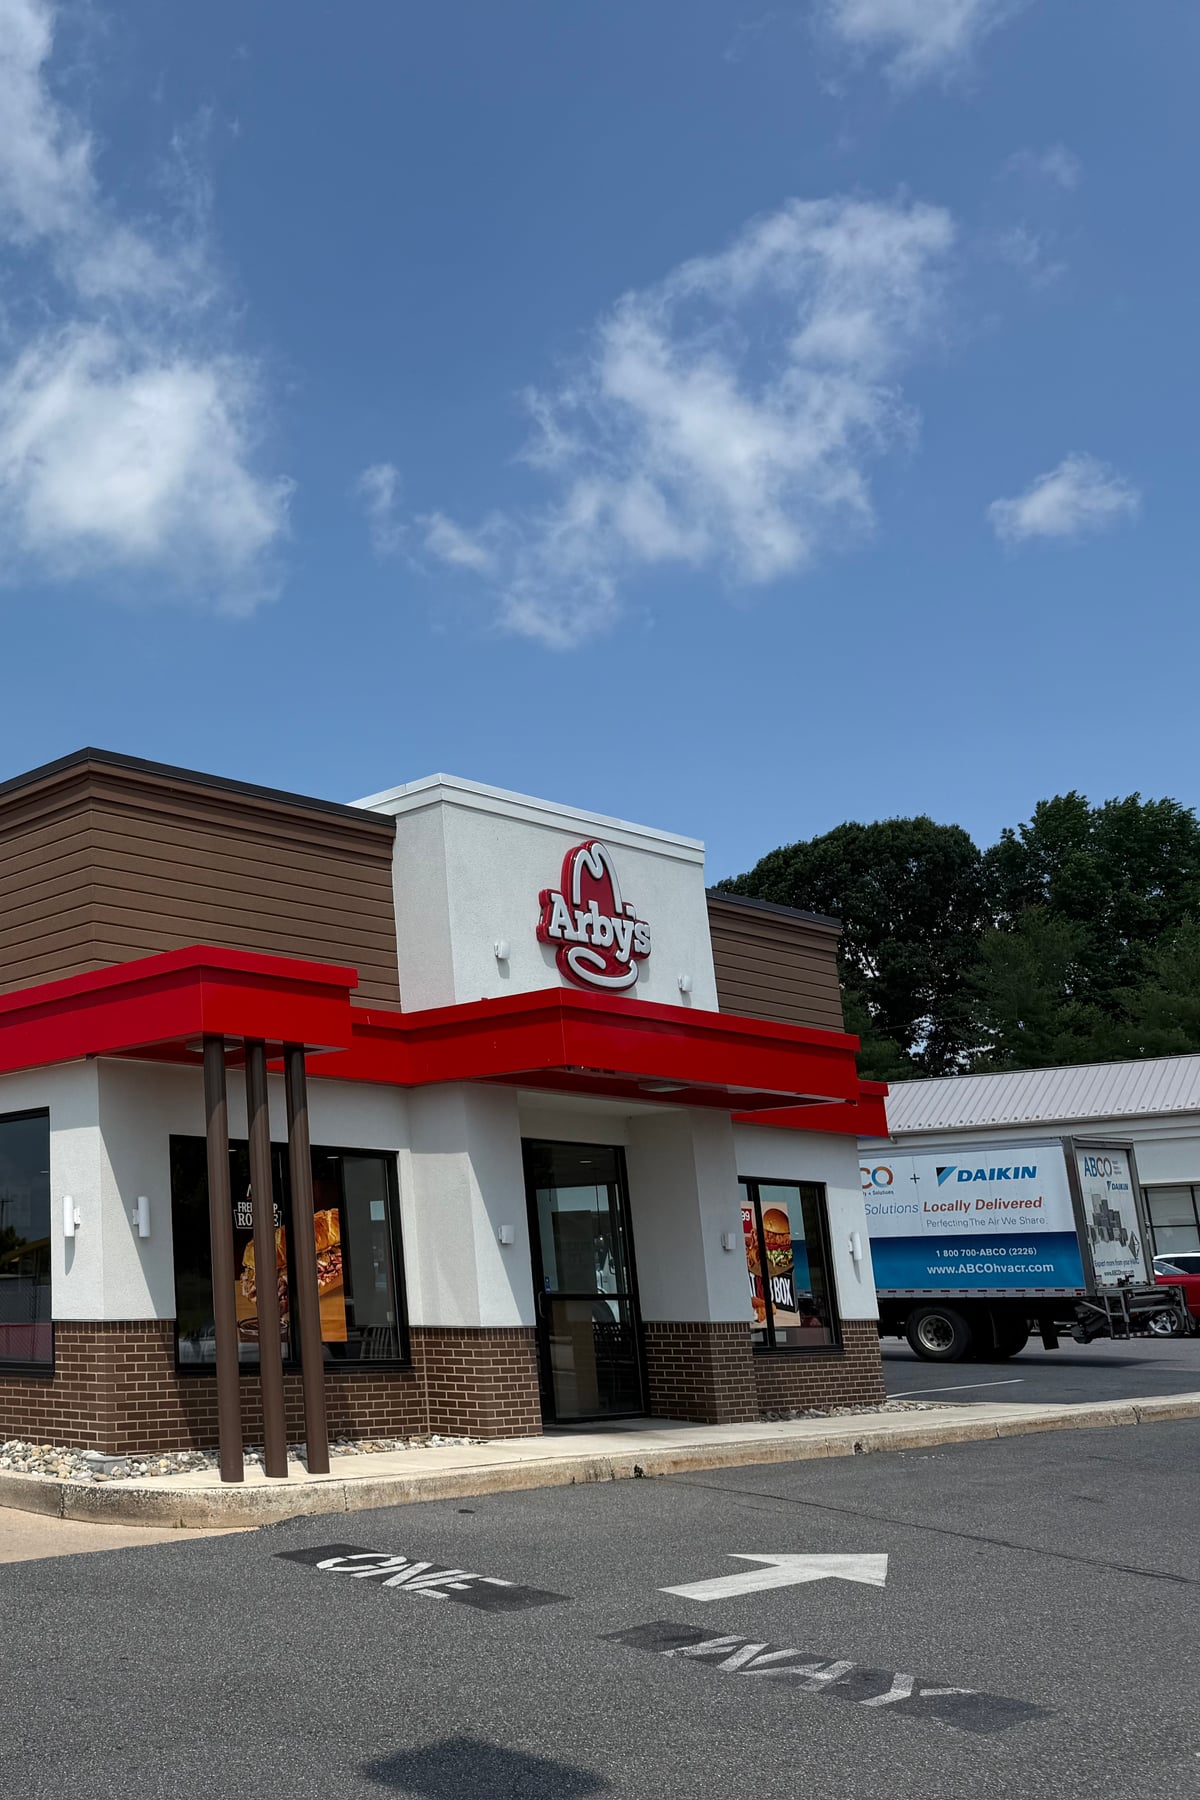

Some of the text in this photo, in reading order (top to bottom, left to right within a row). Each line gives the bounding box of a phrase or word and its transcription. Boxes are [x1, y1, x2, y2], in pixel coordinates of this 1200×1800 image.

[549, 893, 651, 963] Arby's
[957, 1166, 1037, 1182] DAIKIN
[1084, 1157, 1112, 1177] ABCO
[865, 1196, 1042, 1215] Solutions Locally Delivered
[927, 1218, 968, 1228] Perfecting
[969, 1218, 985, 1226] The
[988, 1216, 999, 1225] Air
[1000, 1216, 1016, 1225] We
[943, 1249, 959, 1257] 800
[961, 1248, 1006, 1257] 700-ABCO
[1009, 1247, 1037, 1256] (2226)
[927, 1263, 1054, 1274] www.ABCOhvacr.com
[774, 1277, 793, 1307] BOX
[316, 1553, 517, 1598] ONE
[660, 1635, 973, 1707] WAY
